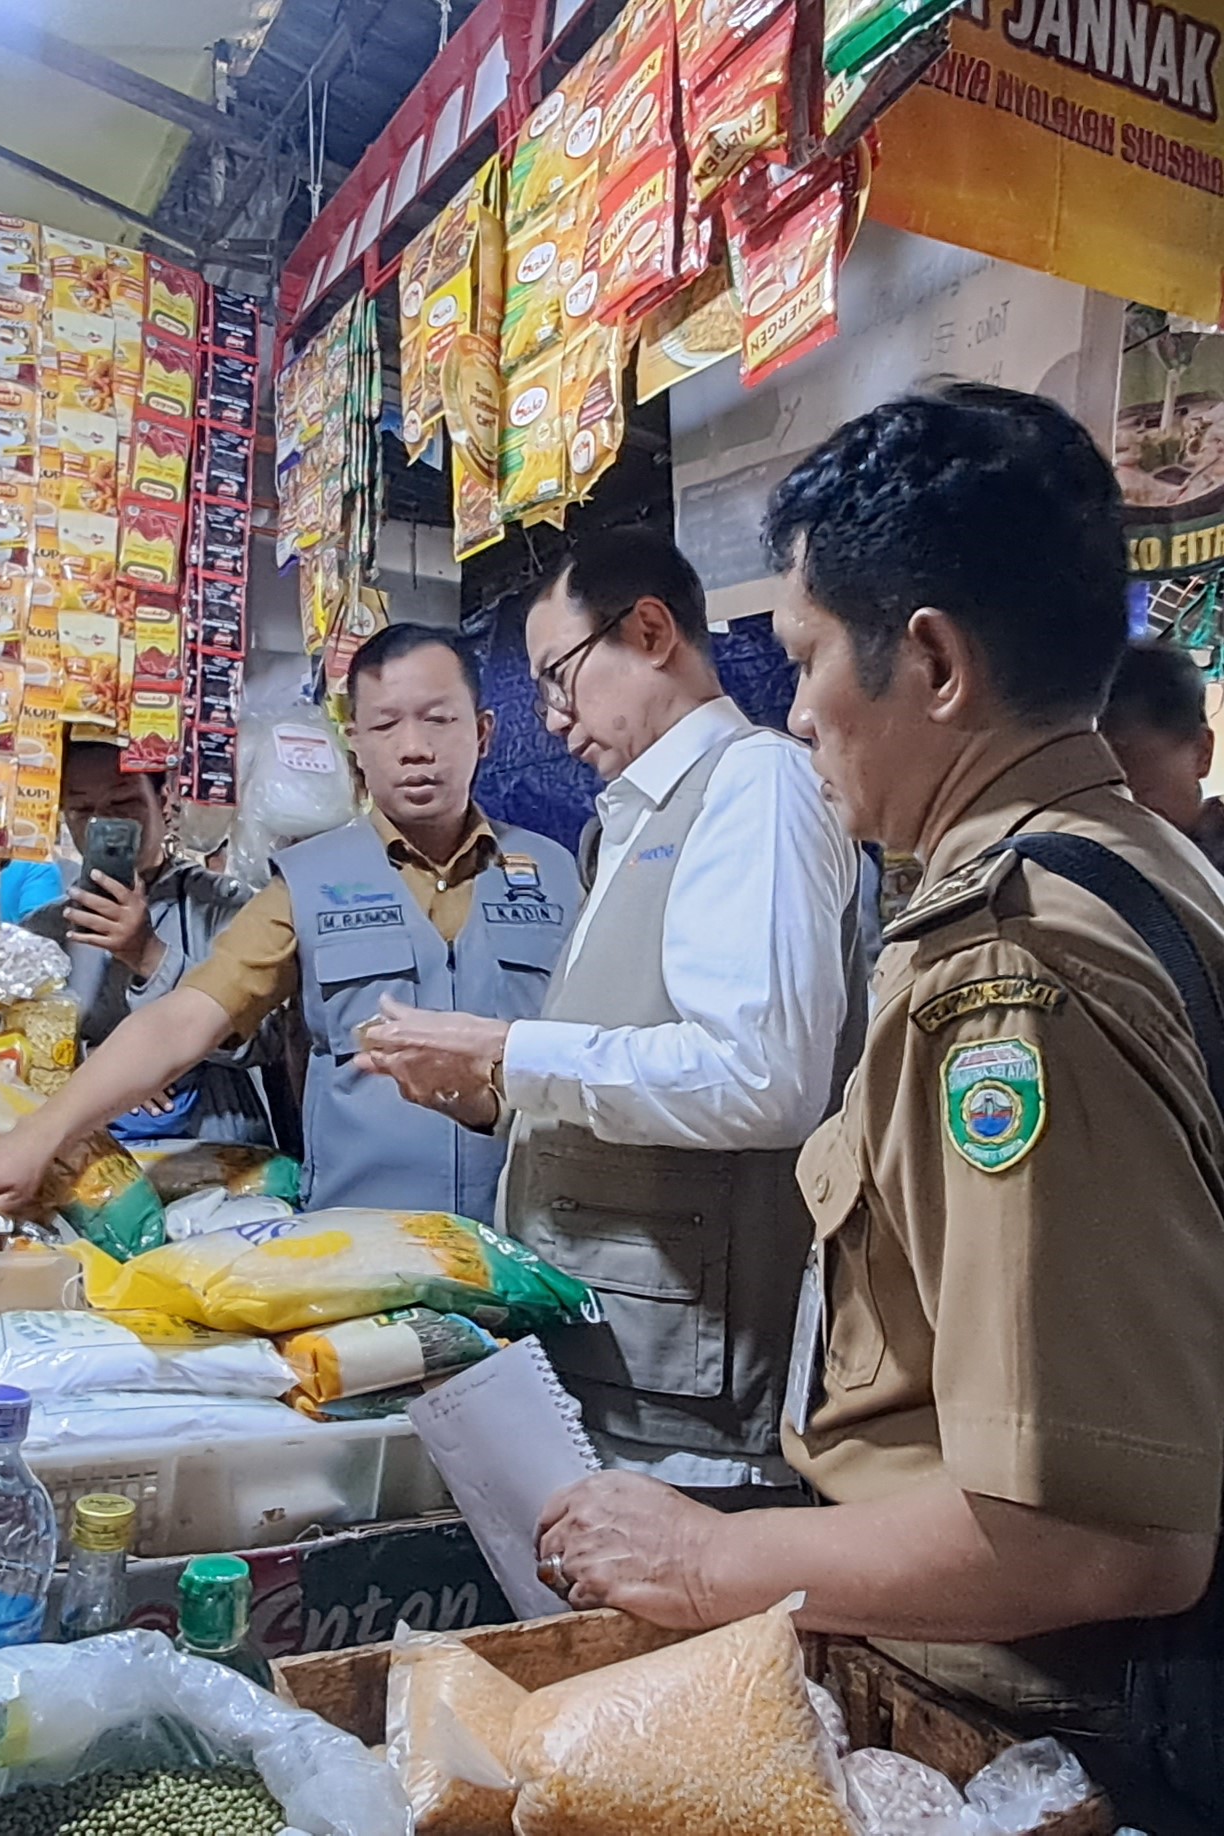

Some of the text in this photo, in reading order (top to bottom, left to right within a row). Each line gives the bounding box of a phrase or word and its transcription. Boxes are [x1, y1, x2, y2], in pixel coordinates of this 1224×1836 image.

[1008, 0, 1216, 115] JANNAK
[602, 182, 659, 253] ENERGEN
[749, 282, 822, 356] ENERGEN
[24, 708, 56, 721] KOPI
[17, 786, 50, 800] KOPI
